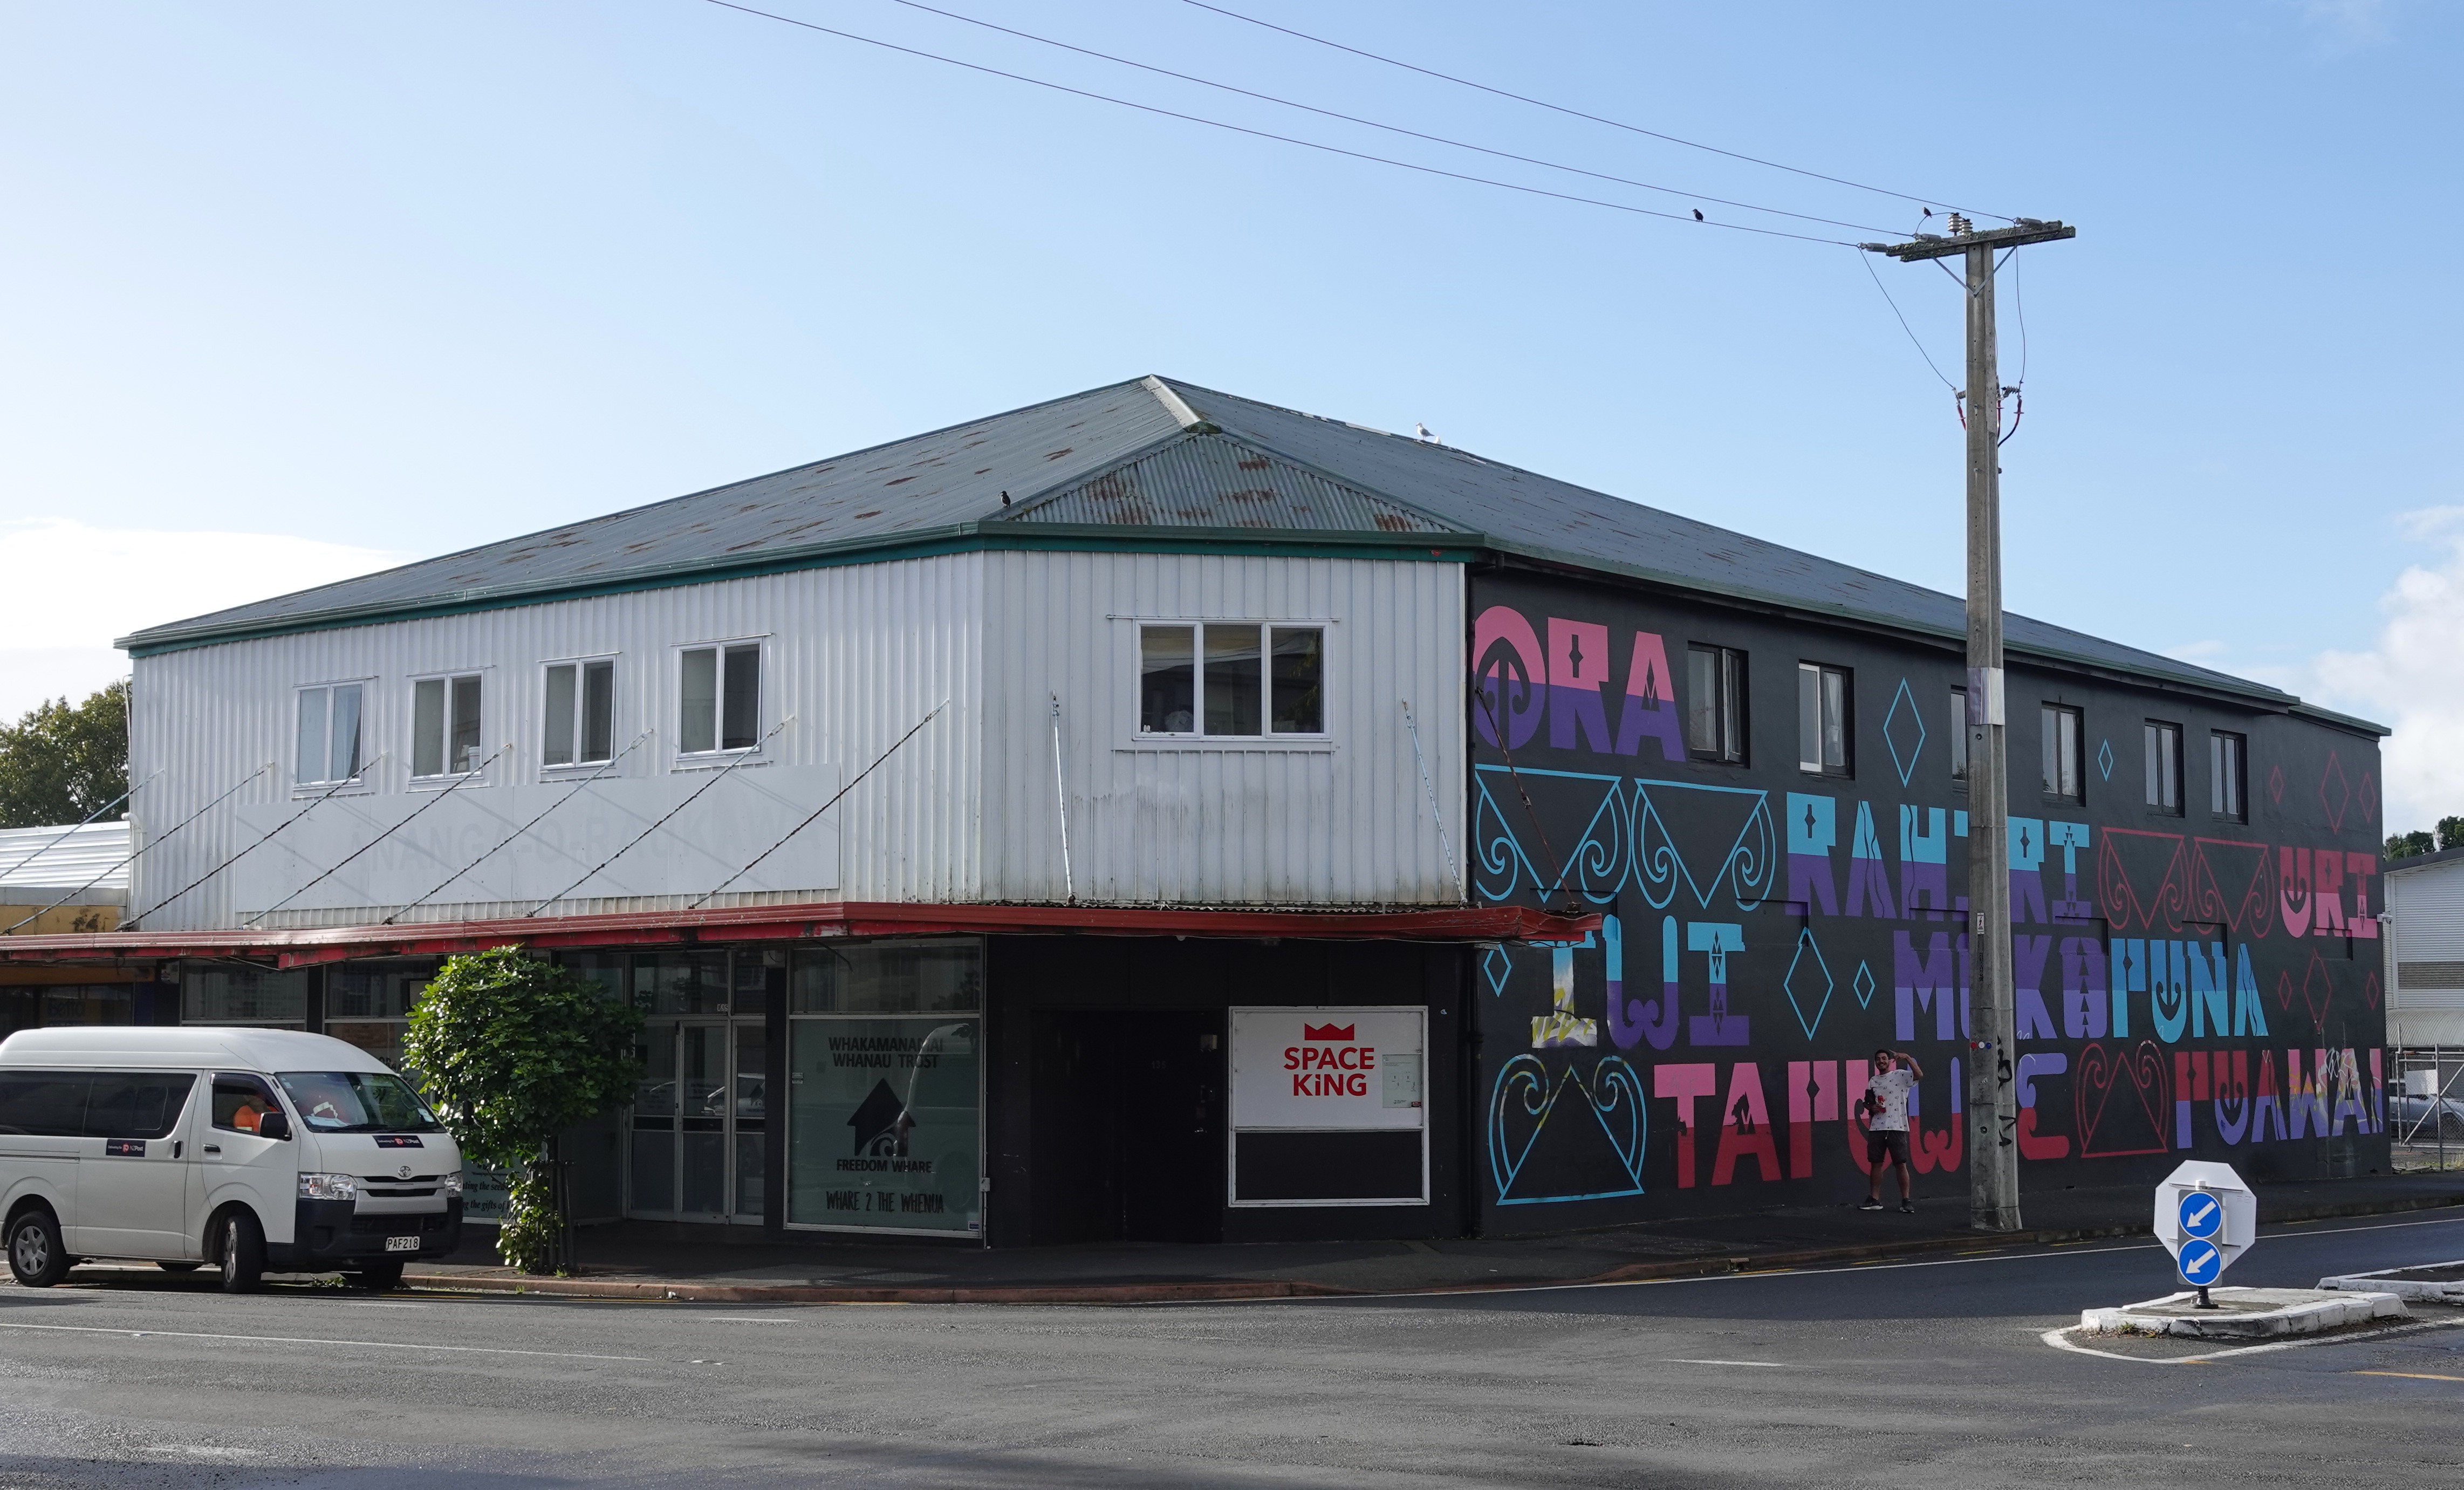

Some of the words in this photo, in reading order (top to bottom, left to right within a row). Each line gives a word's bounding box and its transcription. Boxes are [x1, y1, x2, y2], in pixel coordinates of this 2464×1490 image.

[1473, 605, 1686, 762] ORA
[2279, 846, 2378, 939] URI
[1893, 929, 2269, 1044] MKOPUNA
[833, 1054, 891, 1068] WHANAU
[898, 1054, 939, 1068] TRUST
[1284, 1047, 1375, 1070] SPACE
[1654, 1052, 2070, 1189] TAPUWE
[837, 1159, 888, 1172] FREEDOM
[892, 1160, 933, 1173] WHARE
[479, 1181, 490, 1191] the
[470, 1199, 481, 1208] the
[481, 1200, 497, 1212] gifts
[498, 1201, 506, 1212] of
[826, 1190, 860, 1211] WHARE
[866, 1193, 872, 1212] 2
[877, 1191, 895, 1212] THE
[901, 1193, 943, 1214] WHENUA
[387, 1238, 419, 1250] PAF218
